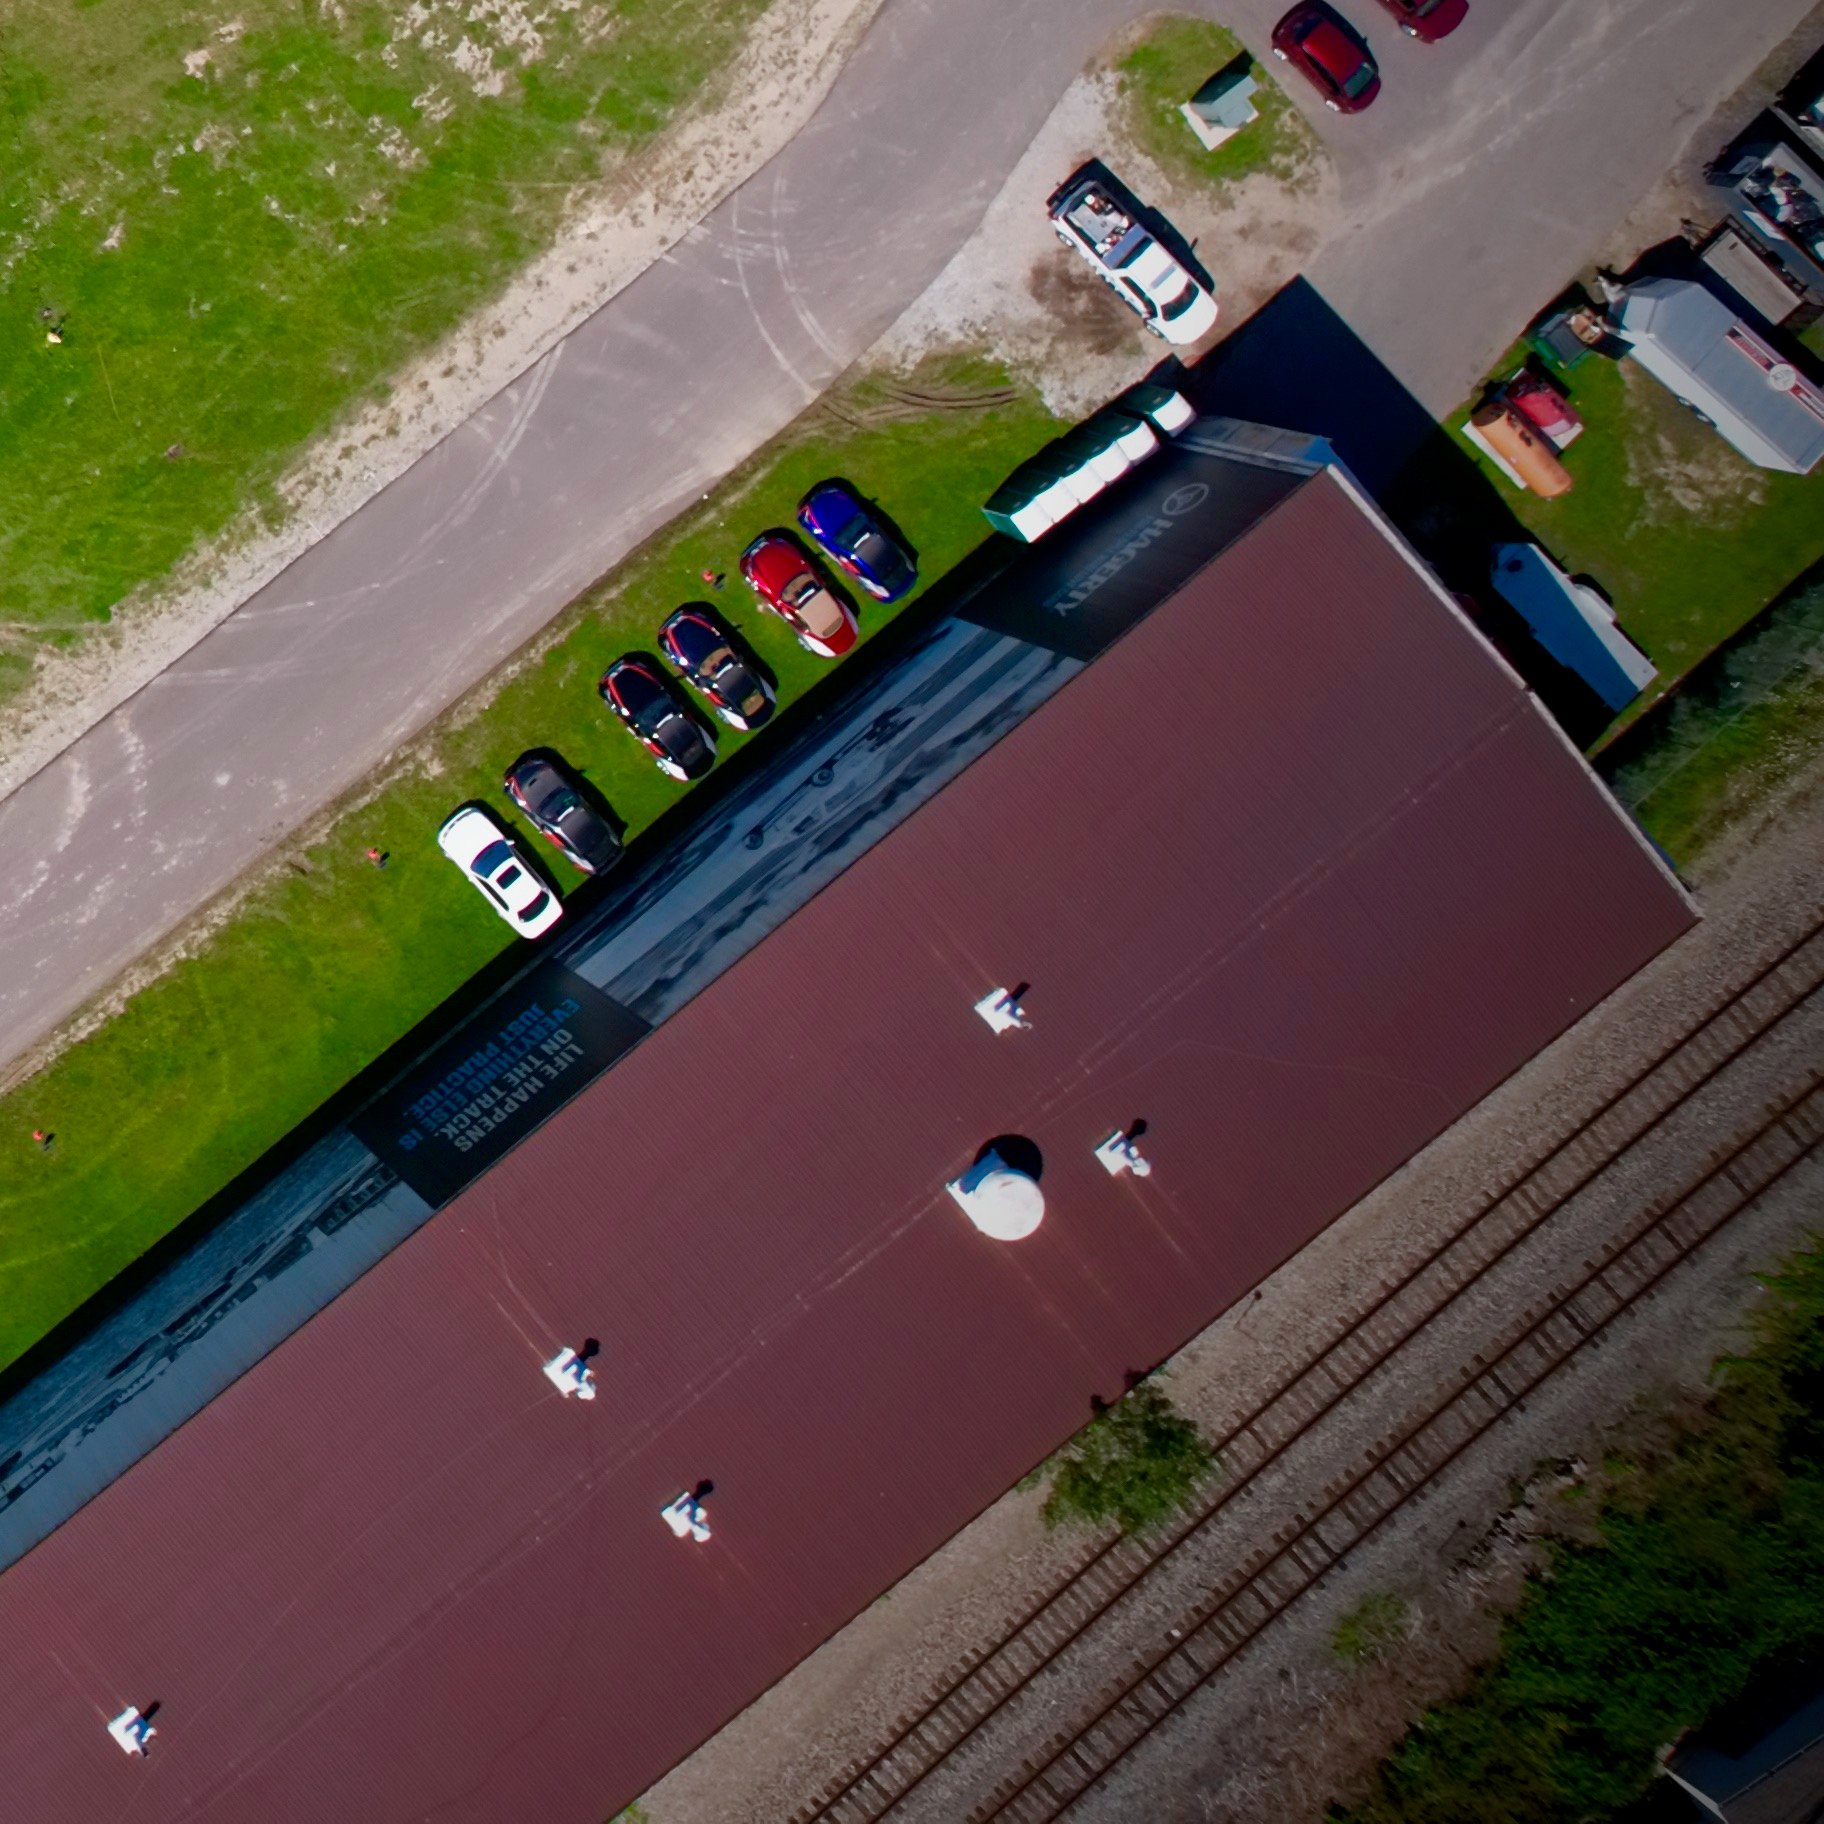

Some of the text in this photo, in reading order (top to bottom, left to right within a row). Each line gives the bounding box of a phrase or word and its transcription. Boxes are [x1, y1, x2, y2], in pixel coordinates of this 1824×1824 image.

[1054, 519, 1175, 616] HAGERTY
[398, 997, 582, 1151] EVERYTHING ELSE IS
[402, 1002, 546, 1119] JUST PRACTICE.
[433, 1028, 574, 1140] ON THE TRACK.
[454, 1043, 585, 1152] LIFE HAPPENS
